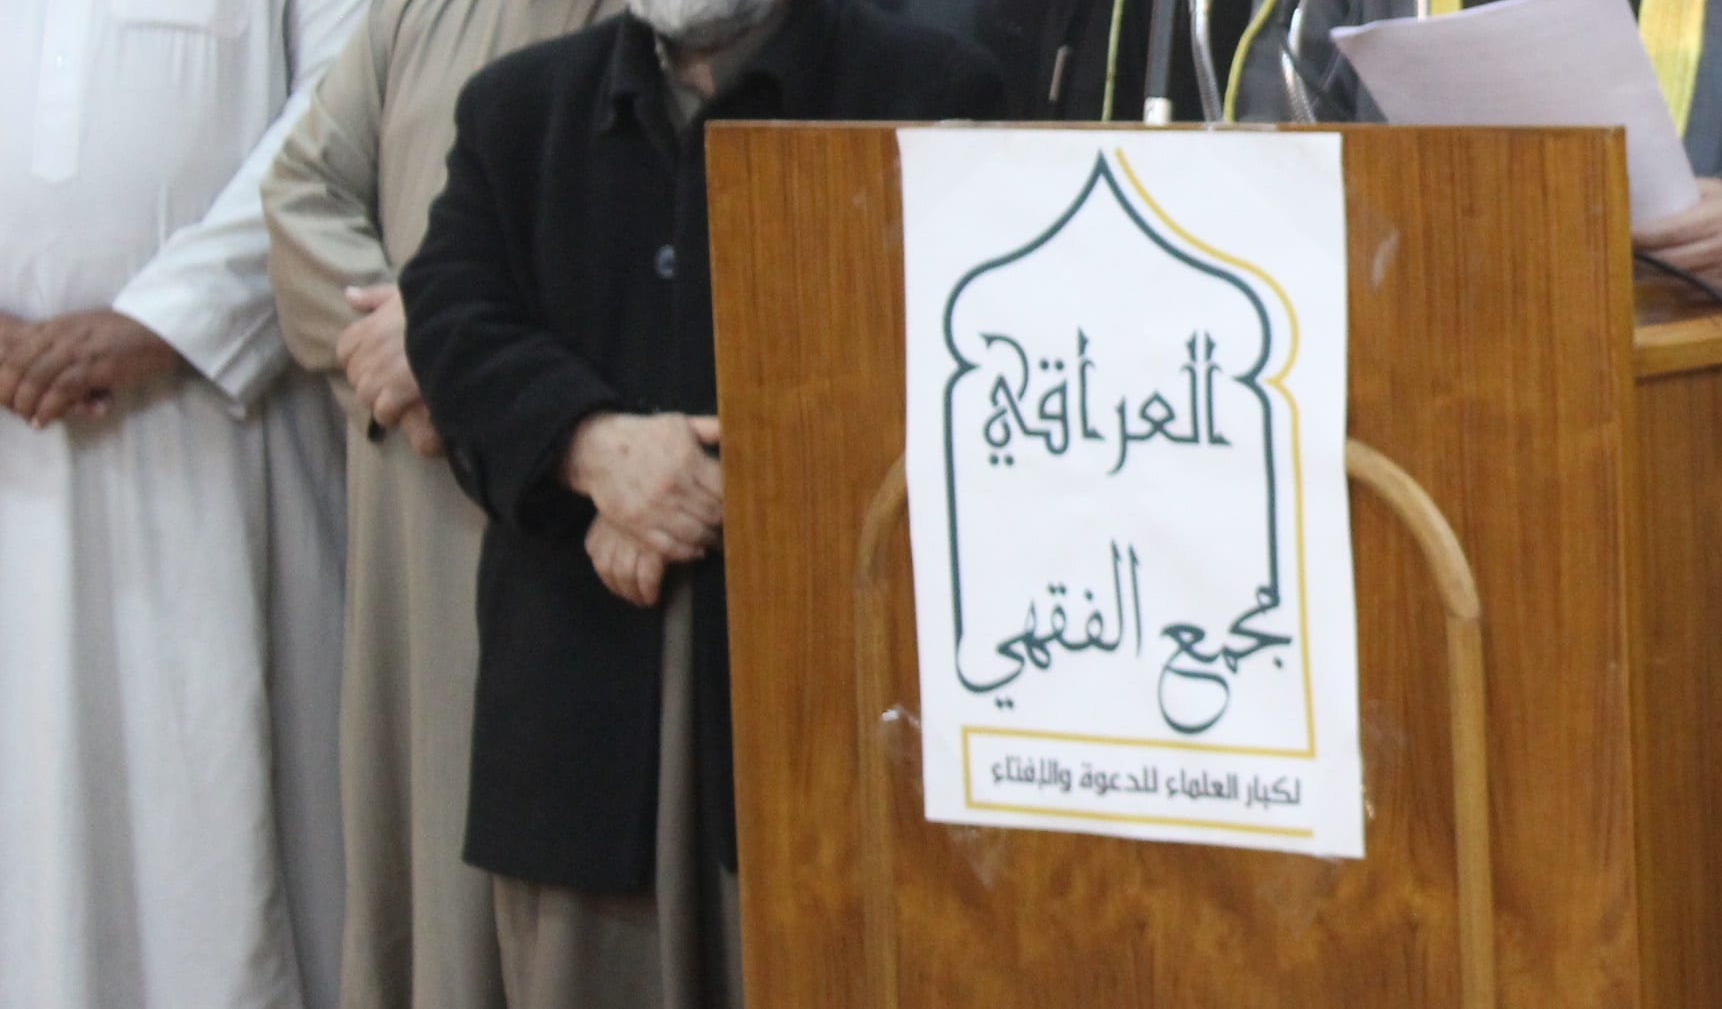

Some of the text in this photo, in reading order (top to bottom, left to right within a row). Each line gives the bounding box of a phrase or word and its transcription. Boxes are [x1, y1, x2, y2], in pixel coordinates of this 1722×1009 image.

[979, 326, 1232, 476] العراقي
[956, 539, 1142, 710] الفقهي
[1079, 761, 1159, 796] للدعوة
[1165, 767, 1239, 800] العلماء
[1246, 774, 1301, 810] لكبار
